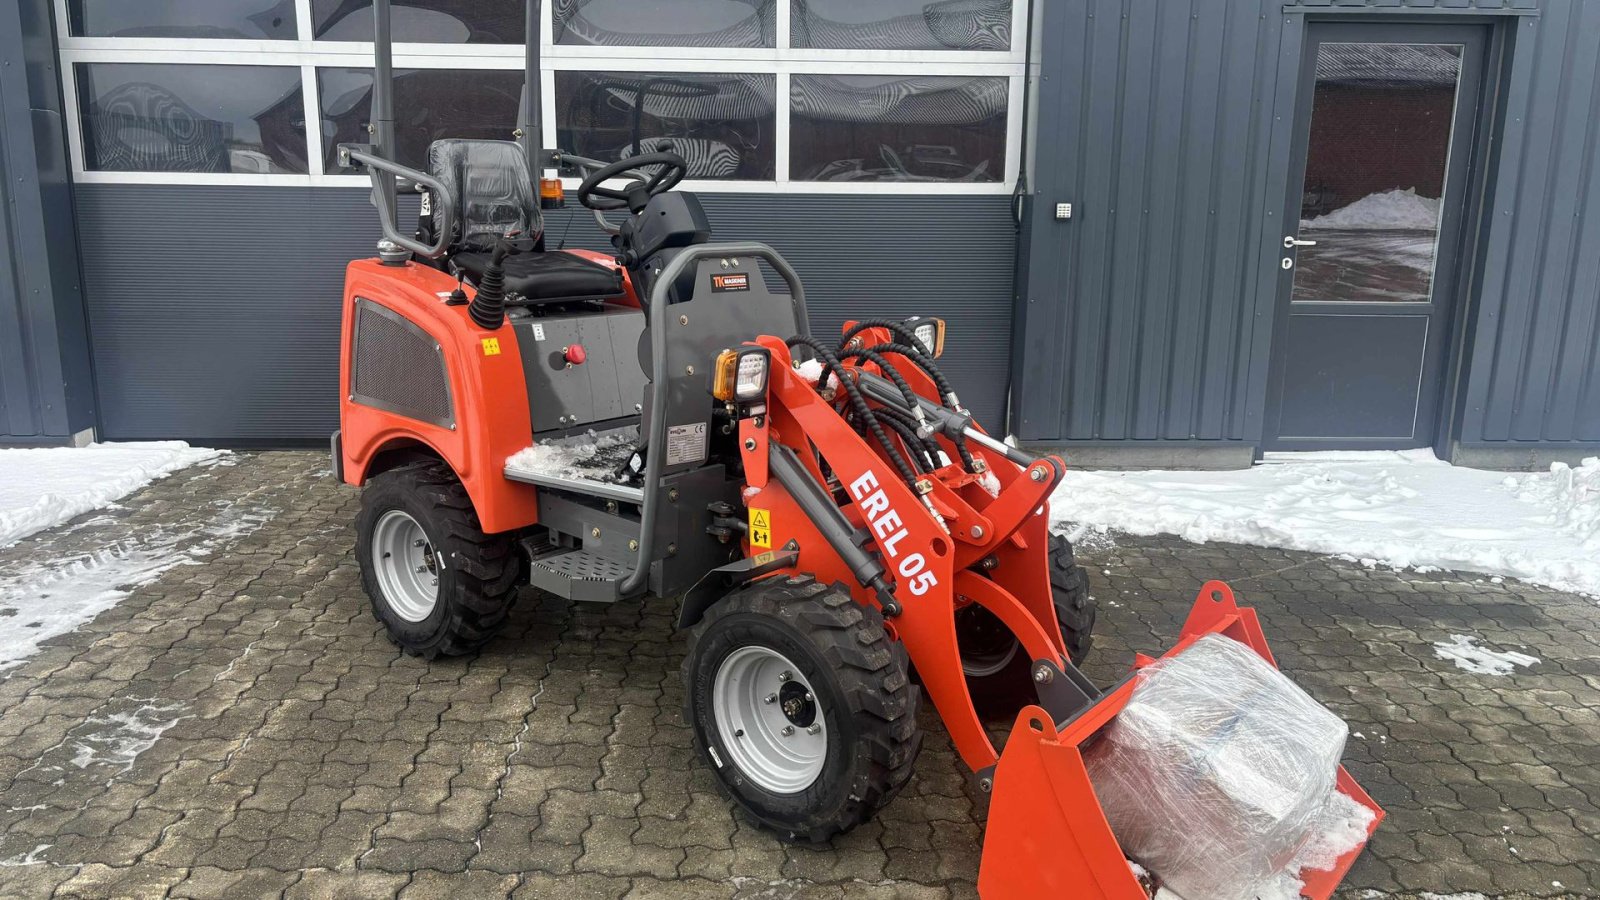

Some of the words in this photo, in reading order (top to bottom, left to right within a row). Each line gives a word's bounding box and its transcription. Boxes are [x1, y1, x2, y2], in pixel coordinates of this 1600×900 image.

[713, 276, 725, 288] TK
[850, 469, 909, 558] EREL
[898, 552, 938, 596] 05
